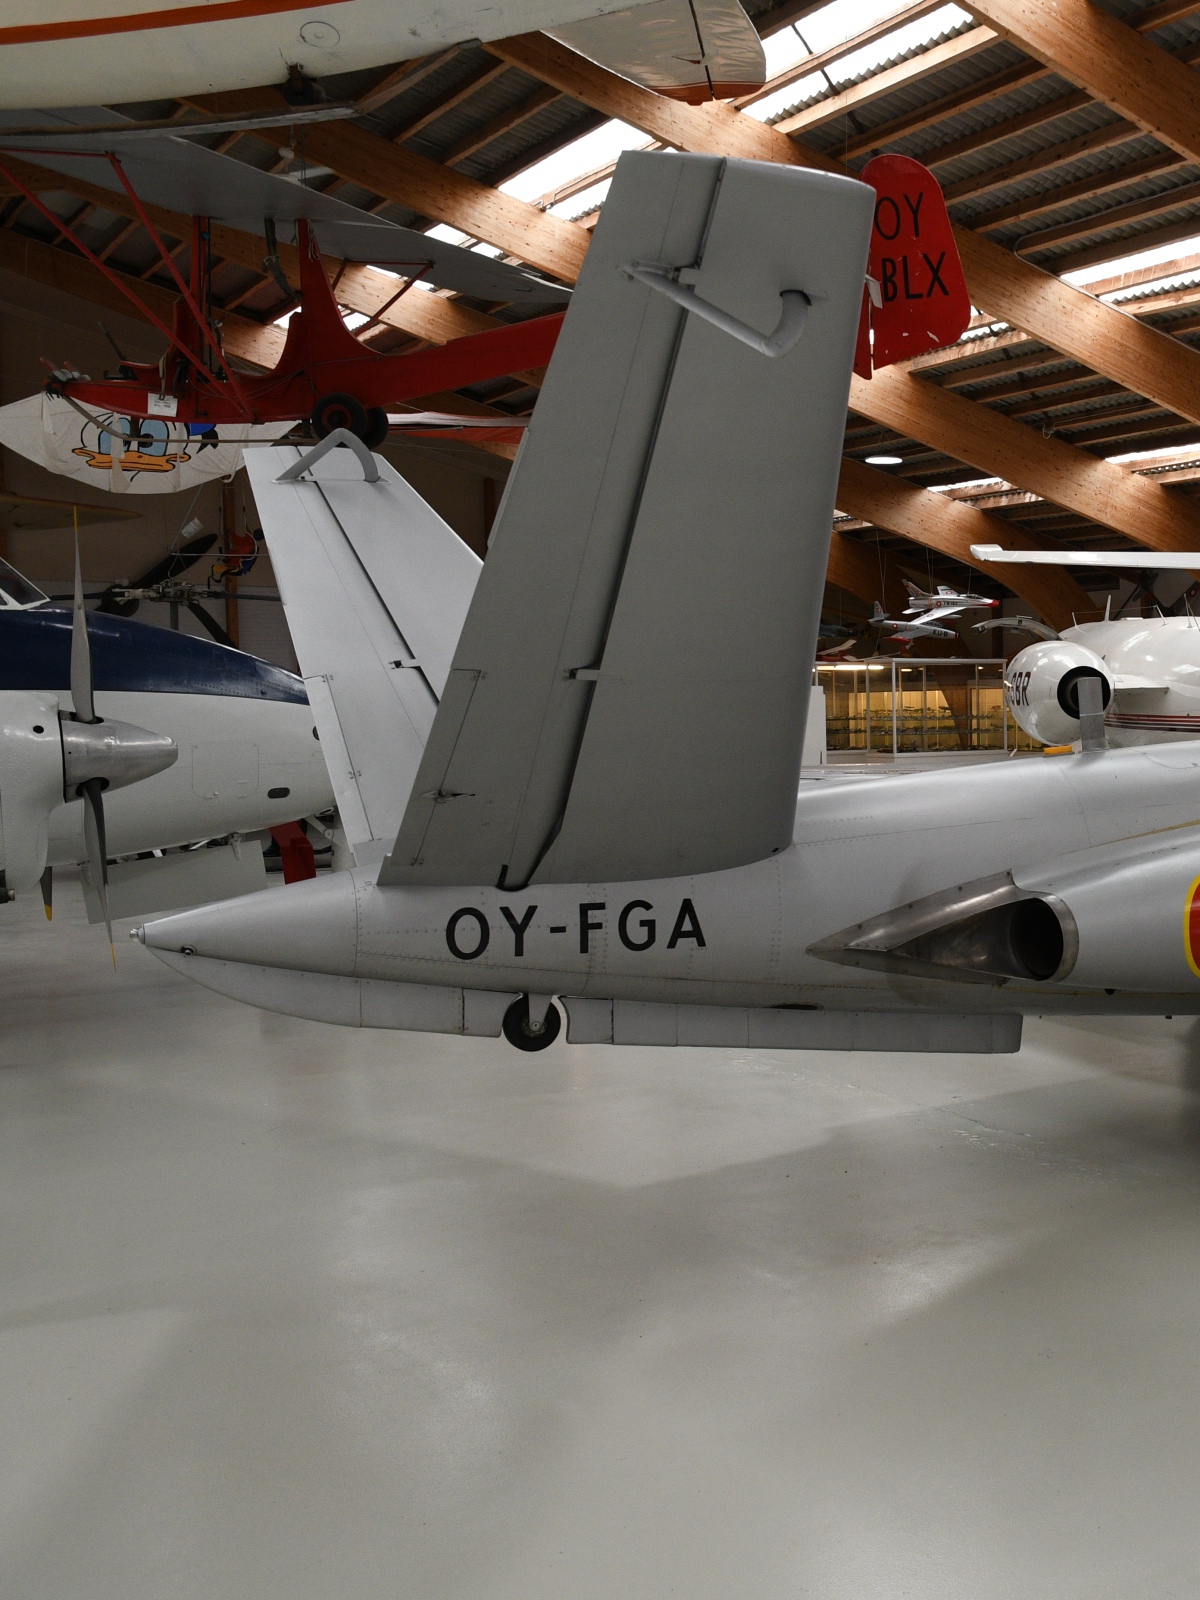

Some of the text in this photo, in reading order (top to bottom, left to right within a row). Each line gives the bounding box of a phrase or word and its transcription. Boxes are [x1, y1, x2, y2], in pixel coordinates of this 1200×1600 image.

[874, 192, 924, 240] OY
[881, 252, 949, 302] BLX
[446, 898, 707, 961] OY-FGA
